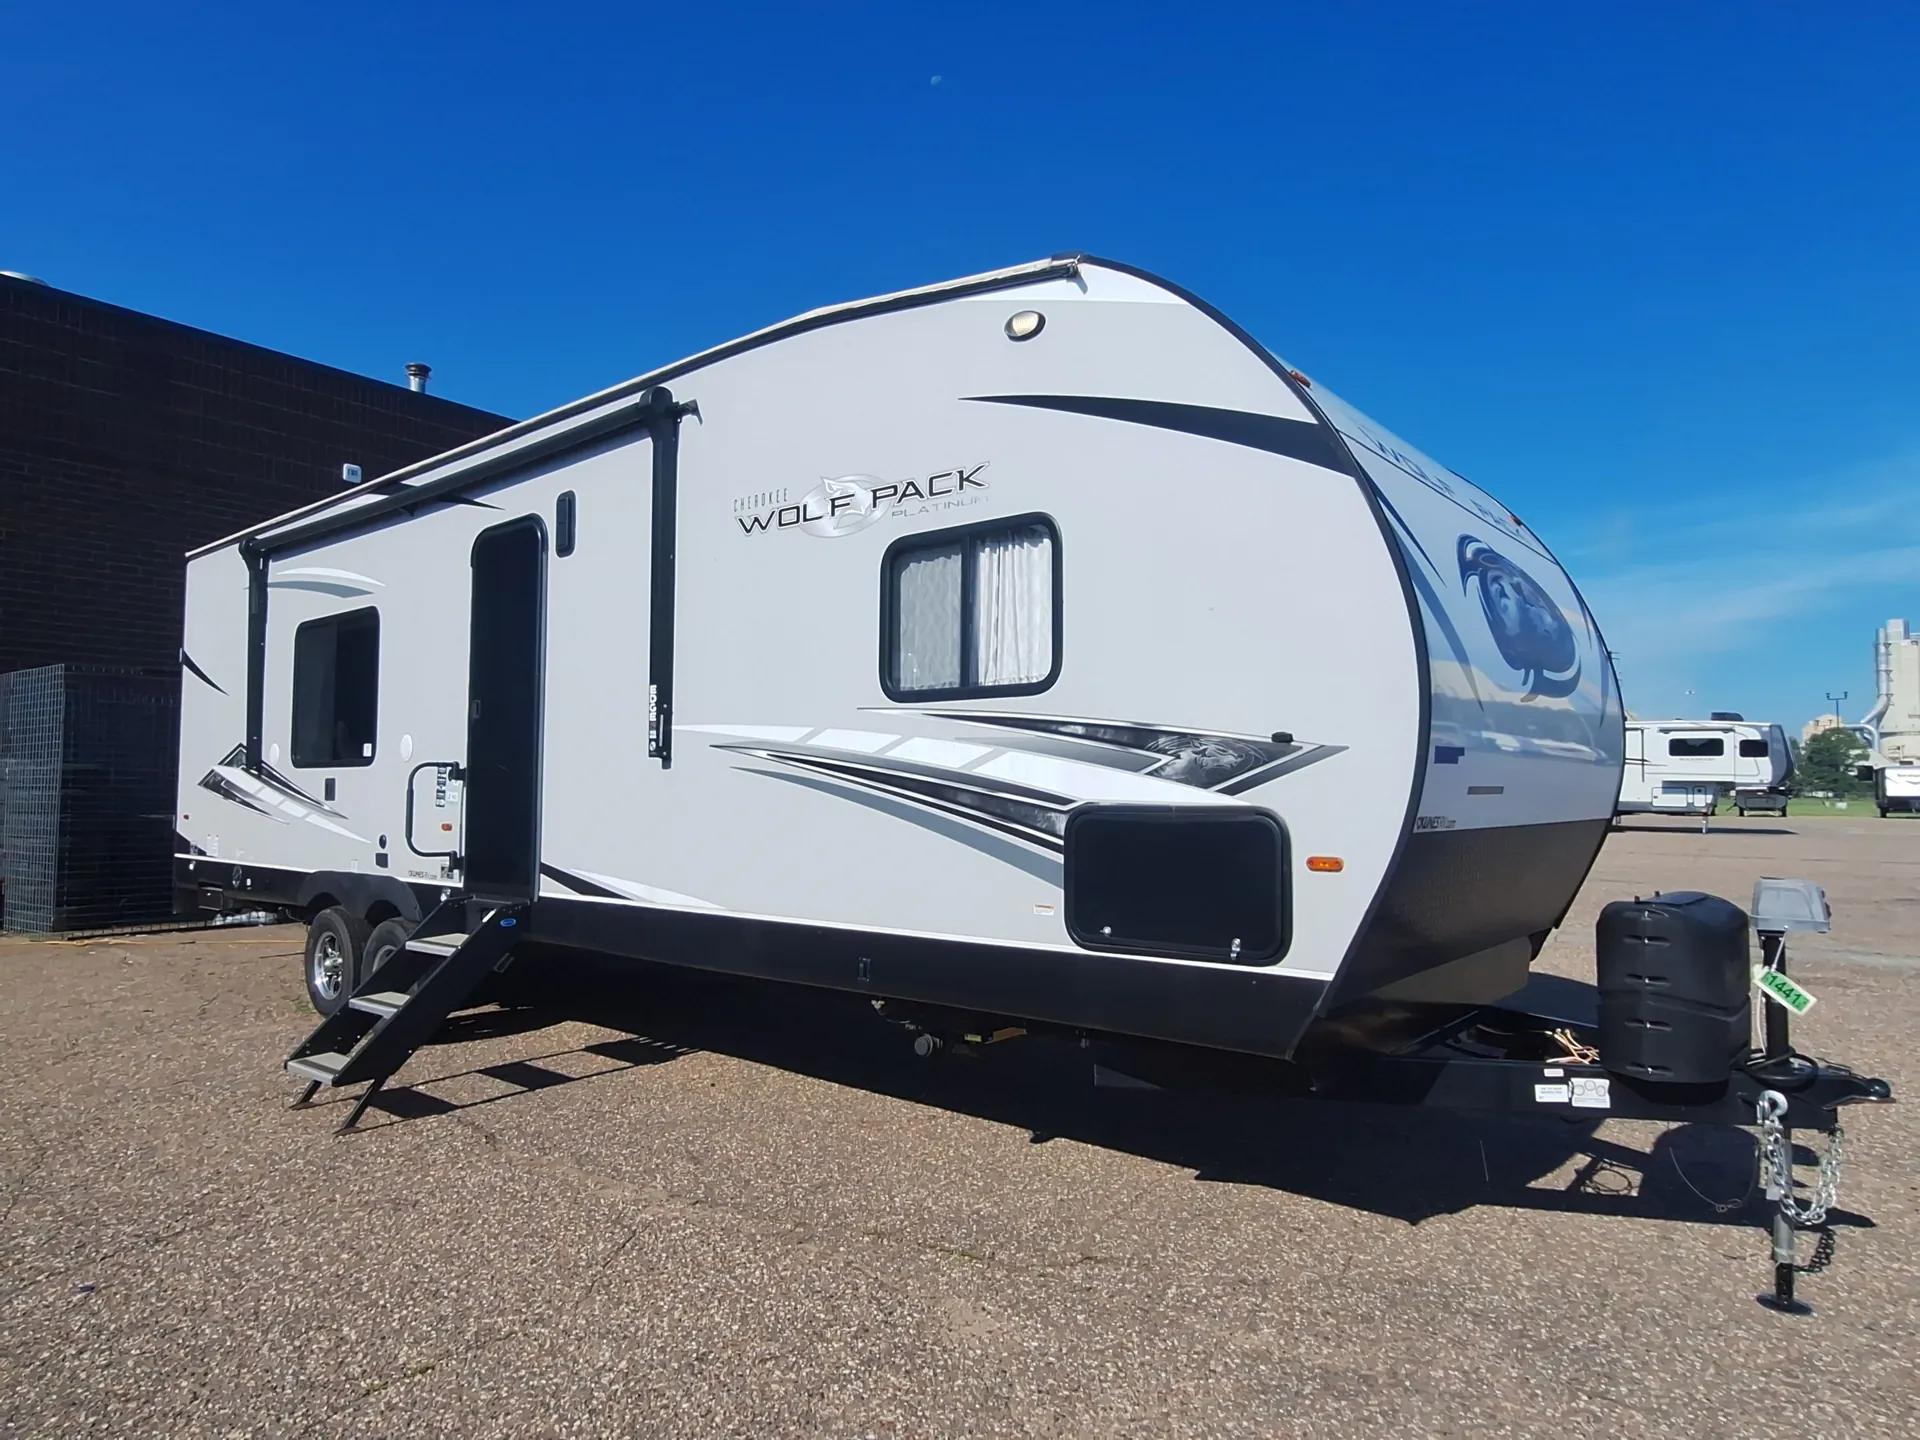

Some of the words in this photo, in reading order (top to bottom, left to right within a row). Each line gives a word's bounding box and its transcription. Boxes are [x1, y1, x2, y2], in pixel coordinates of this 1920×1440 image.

[733, 487, 788, 513] CHEROKEE
[737, 493, 856, 534] WOLF
[871, 462, 989, 508] PACK
[891, 496, 989, 520] PLATINUM
[1767, 974, 1802, 1005] 1441
